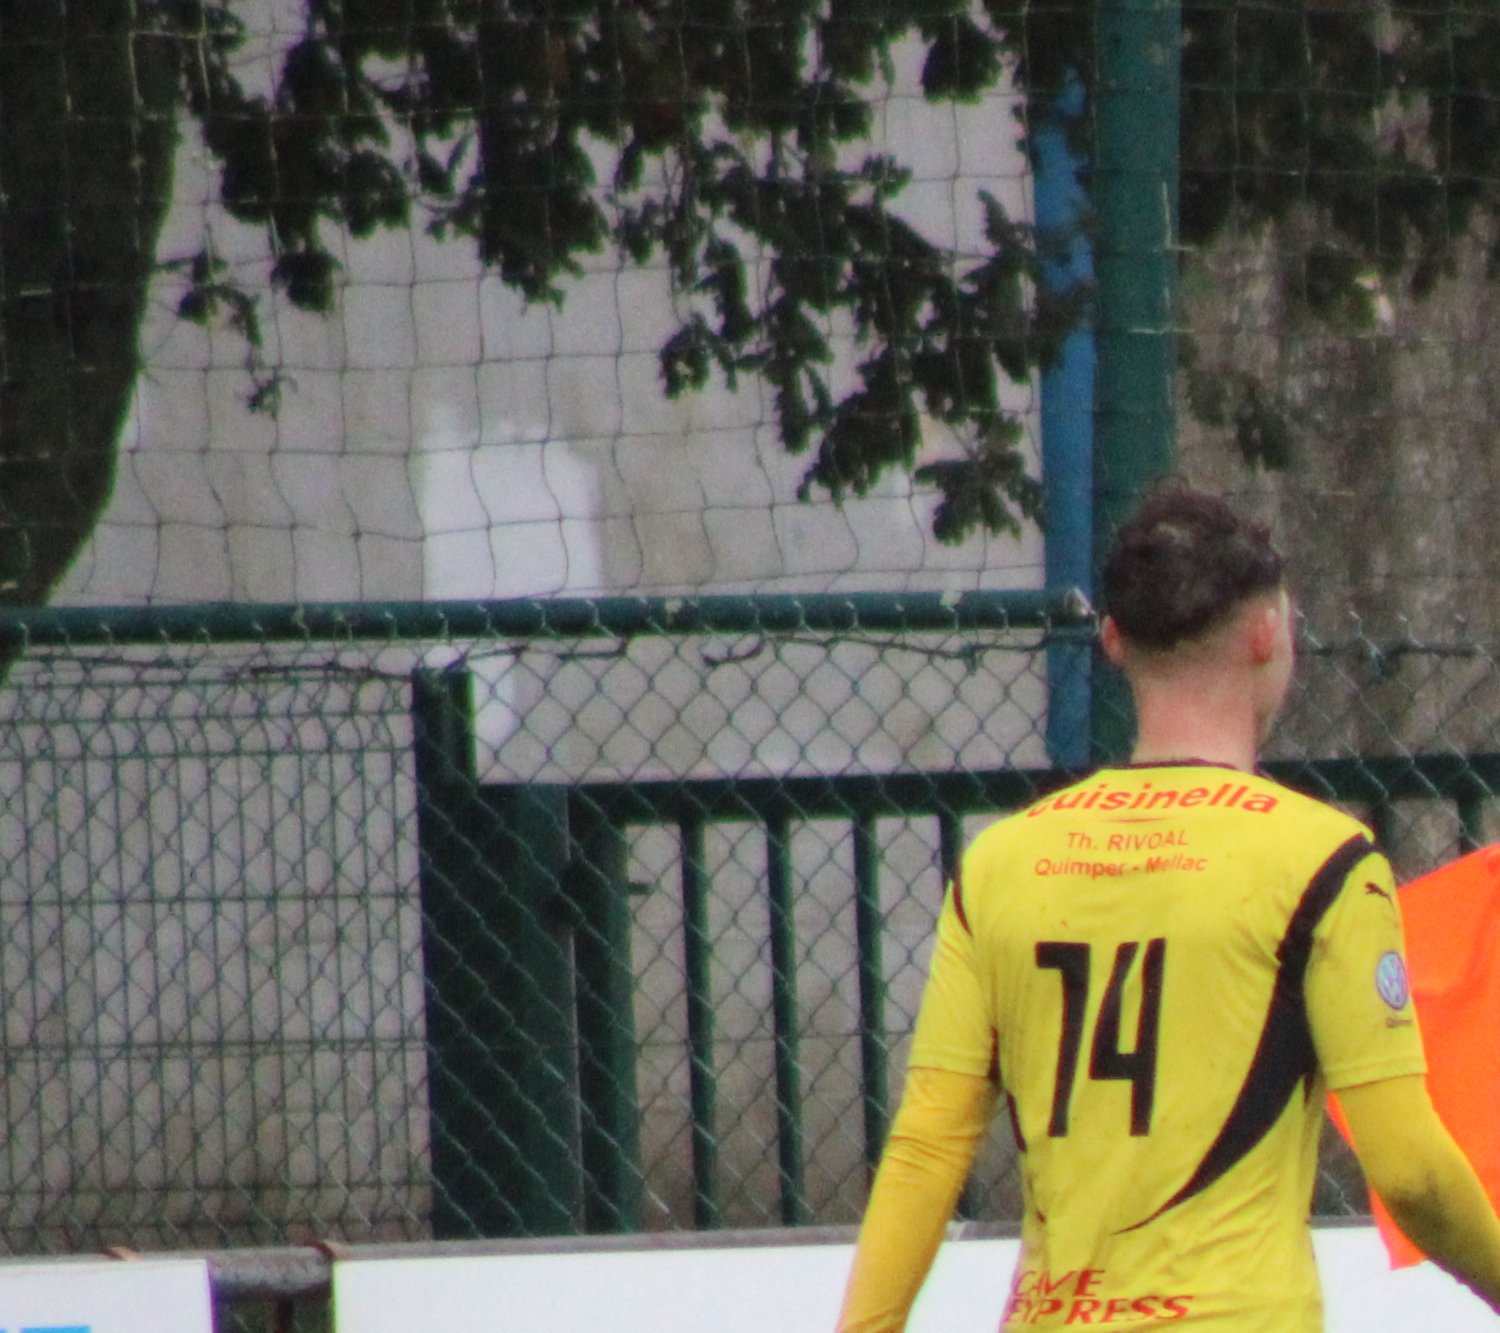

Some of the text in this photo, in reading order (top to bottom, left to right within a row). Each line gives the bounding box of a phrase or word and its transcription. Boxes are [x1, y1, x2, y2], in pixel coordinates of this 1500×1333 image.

[1107, 830, 1189, 851] RIVOAL
[1034, 858, 1126, 880] Quimper
[1145, 855, 1208, 873] Mellac
[1035, 937, 1167, 1138] 14
